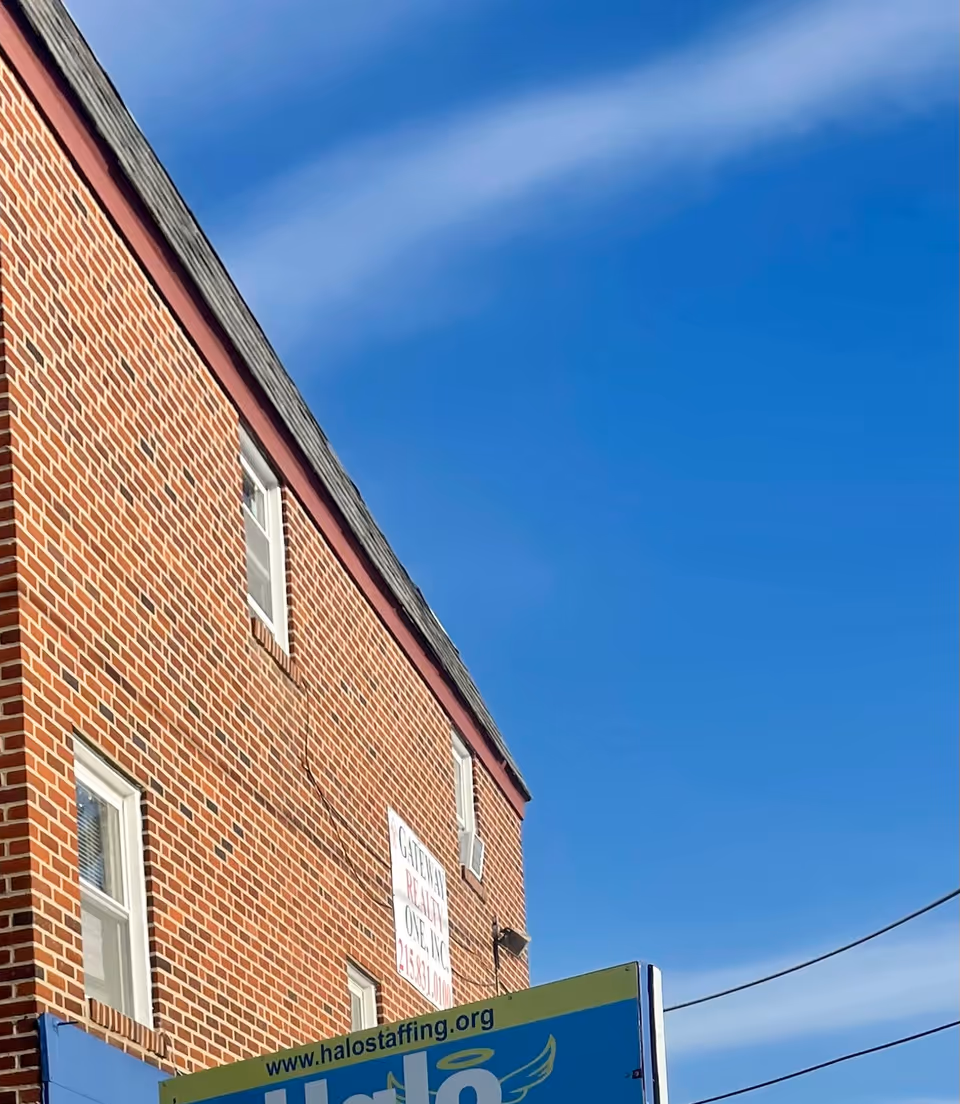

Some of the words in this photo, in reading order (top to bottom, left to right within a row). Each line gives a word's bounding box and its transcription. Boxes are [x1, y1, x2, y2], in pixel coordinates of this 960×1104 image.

[398, 826, 445, 900] GATEWAY
[406, 868, 443, 934] REALTY
[405, 905, 430, 954] ONE,
[430, 930, 449, 974] INC.
[265, 1005, 495, 1077] www.halostaffing.org
